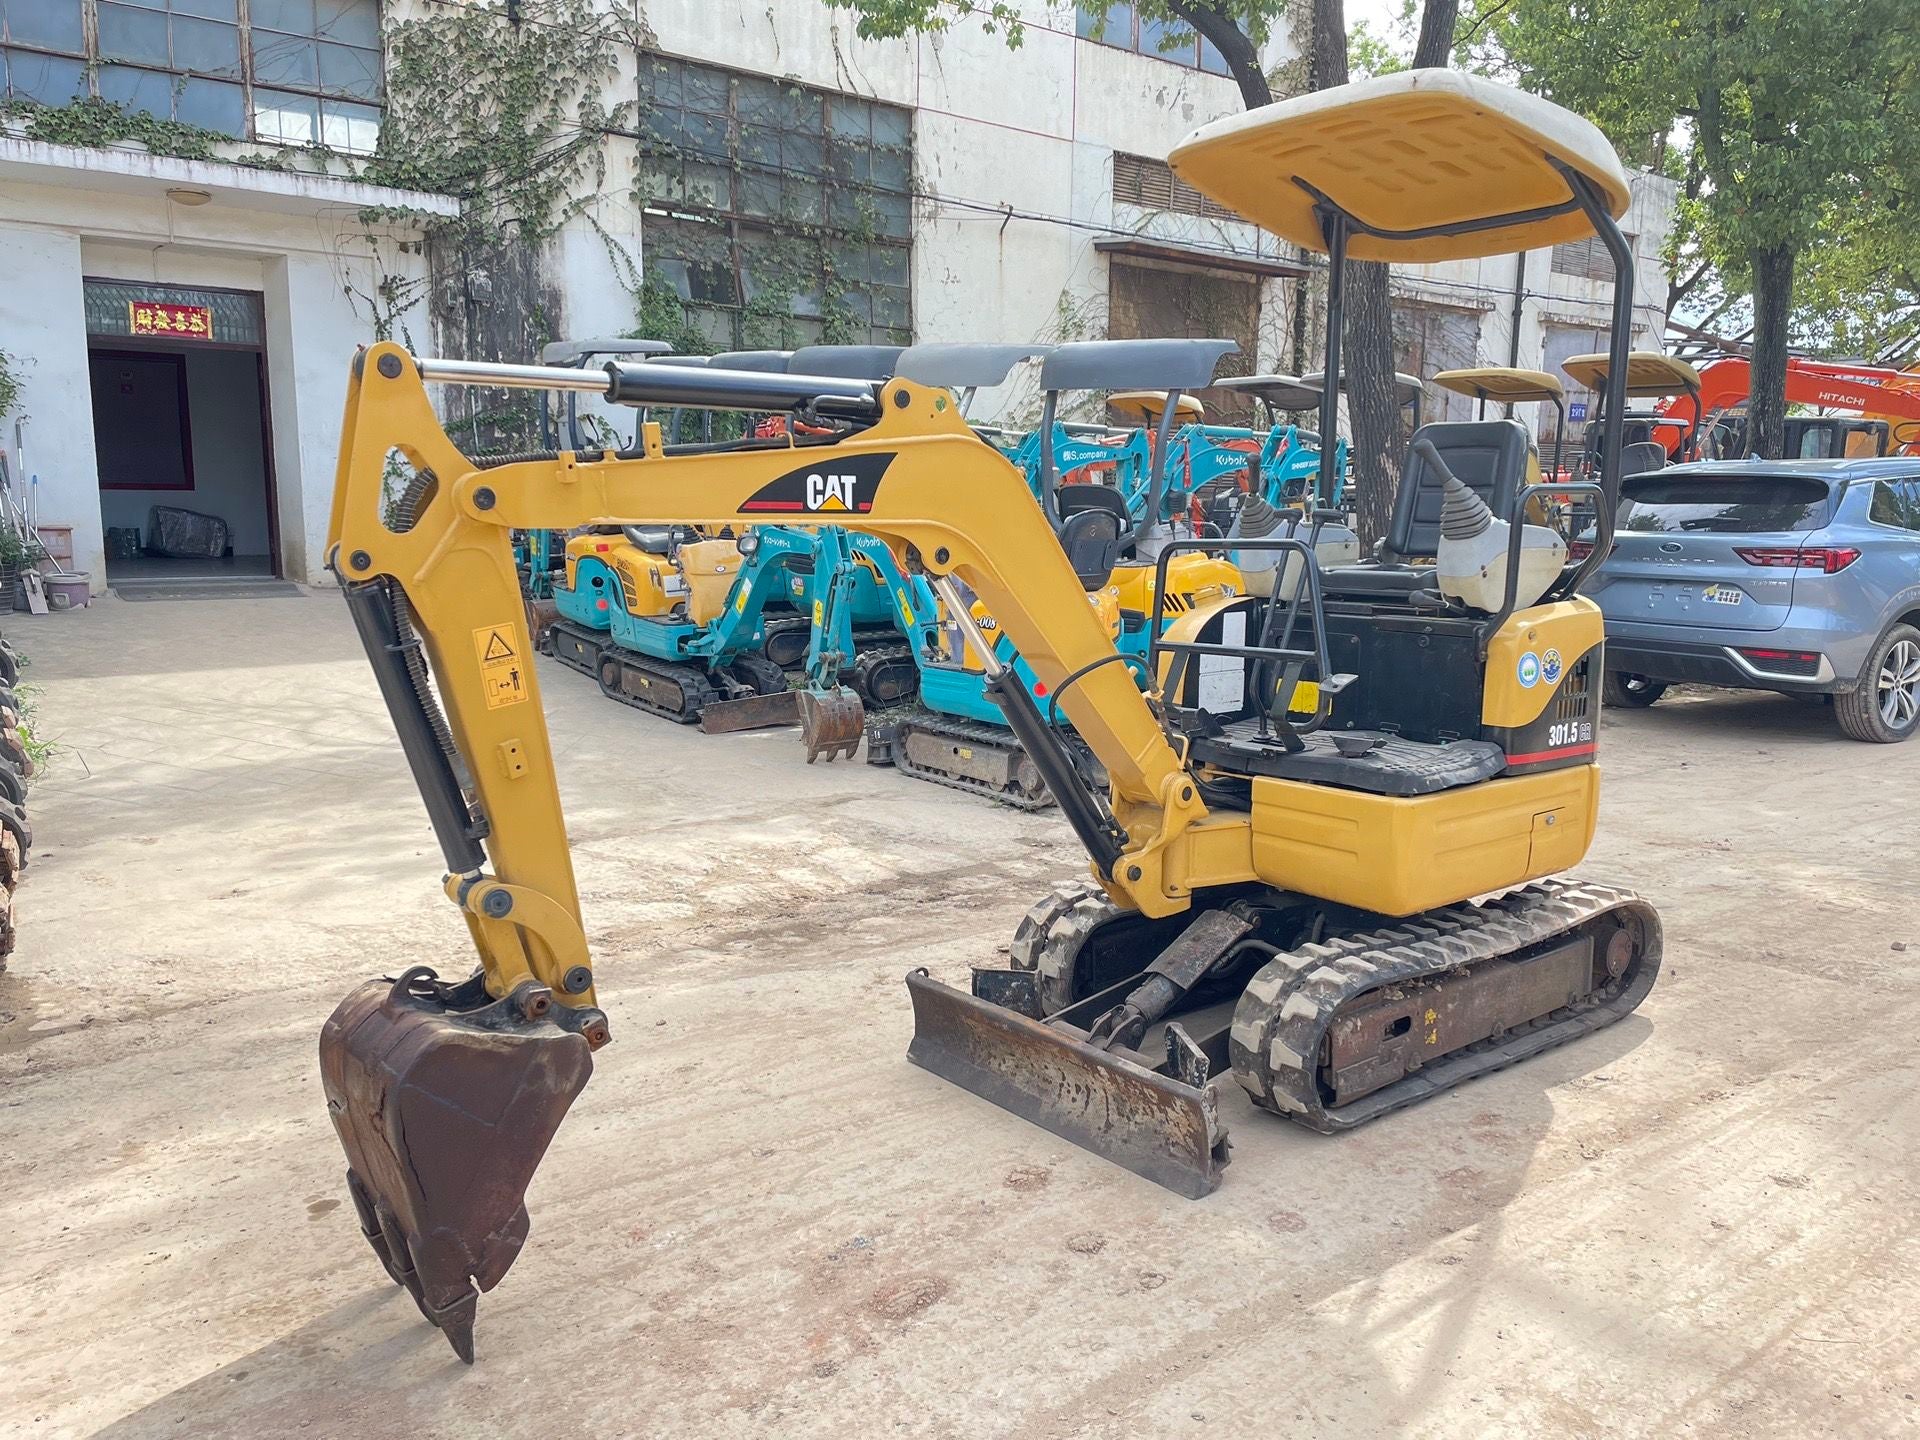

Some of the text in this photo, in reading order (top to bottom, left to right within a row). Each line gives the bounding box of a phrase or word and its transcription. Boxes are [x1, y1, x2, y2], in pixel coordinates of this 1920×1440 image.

[1818, 391, 1866, 406] HITACHI
[806, 473, 857, 511] CAT
[856, 536, 881, 547] Kubota
[1548, 721, 1579, 747] 301.5
